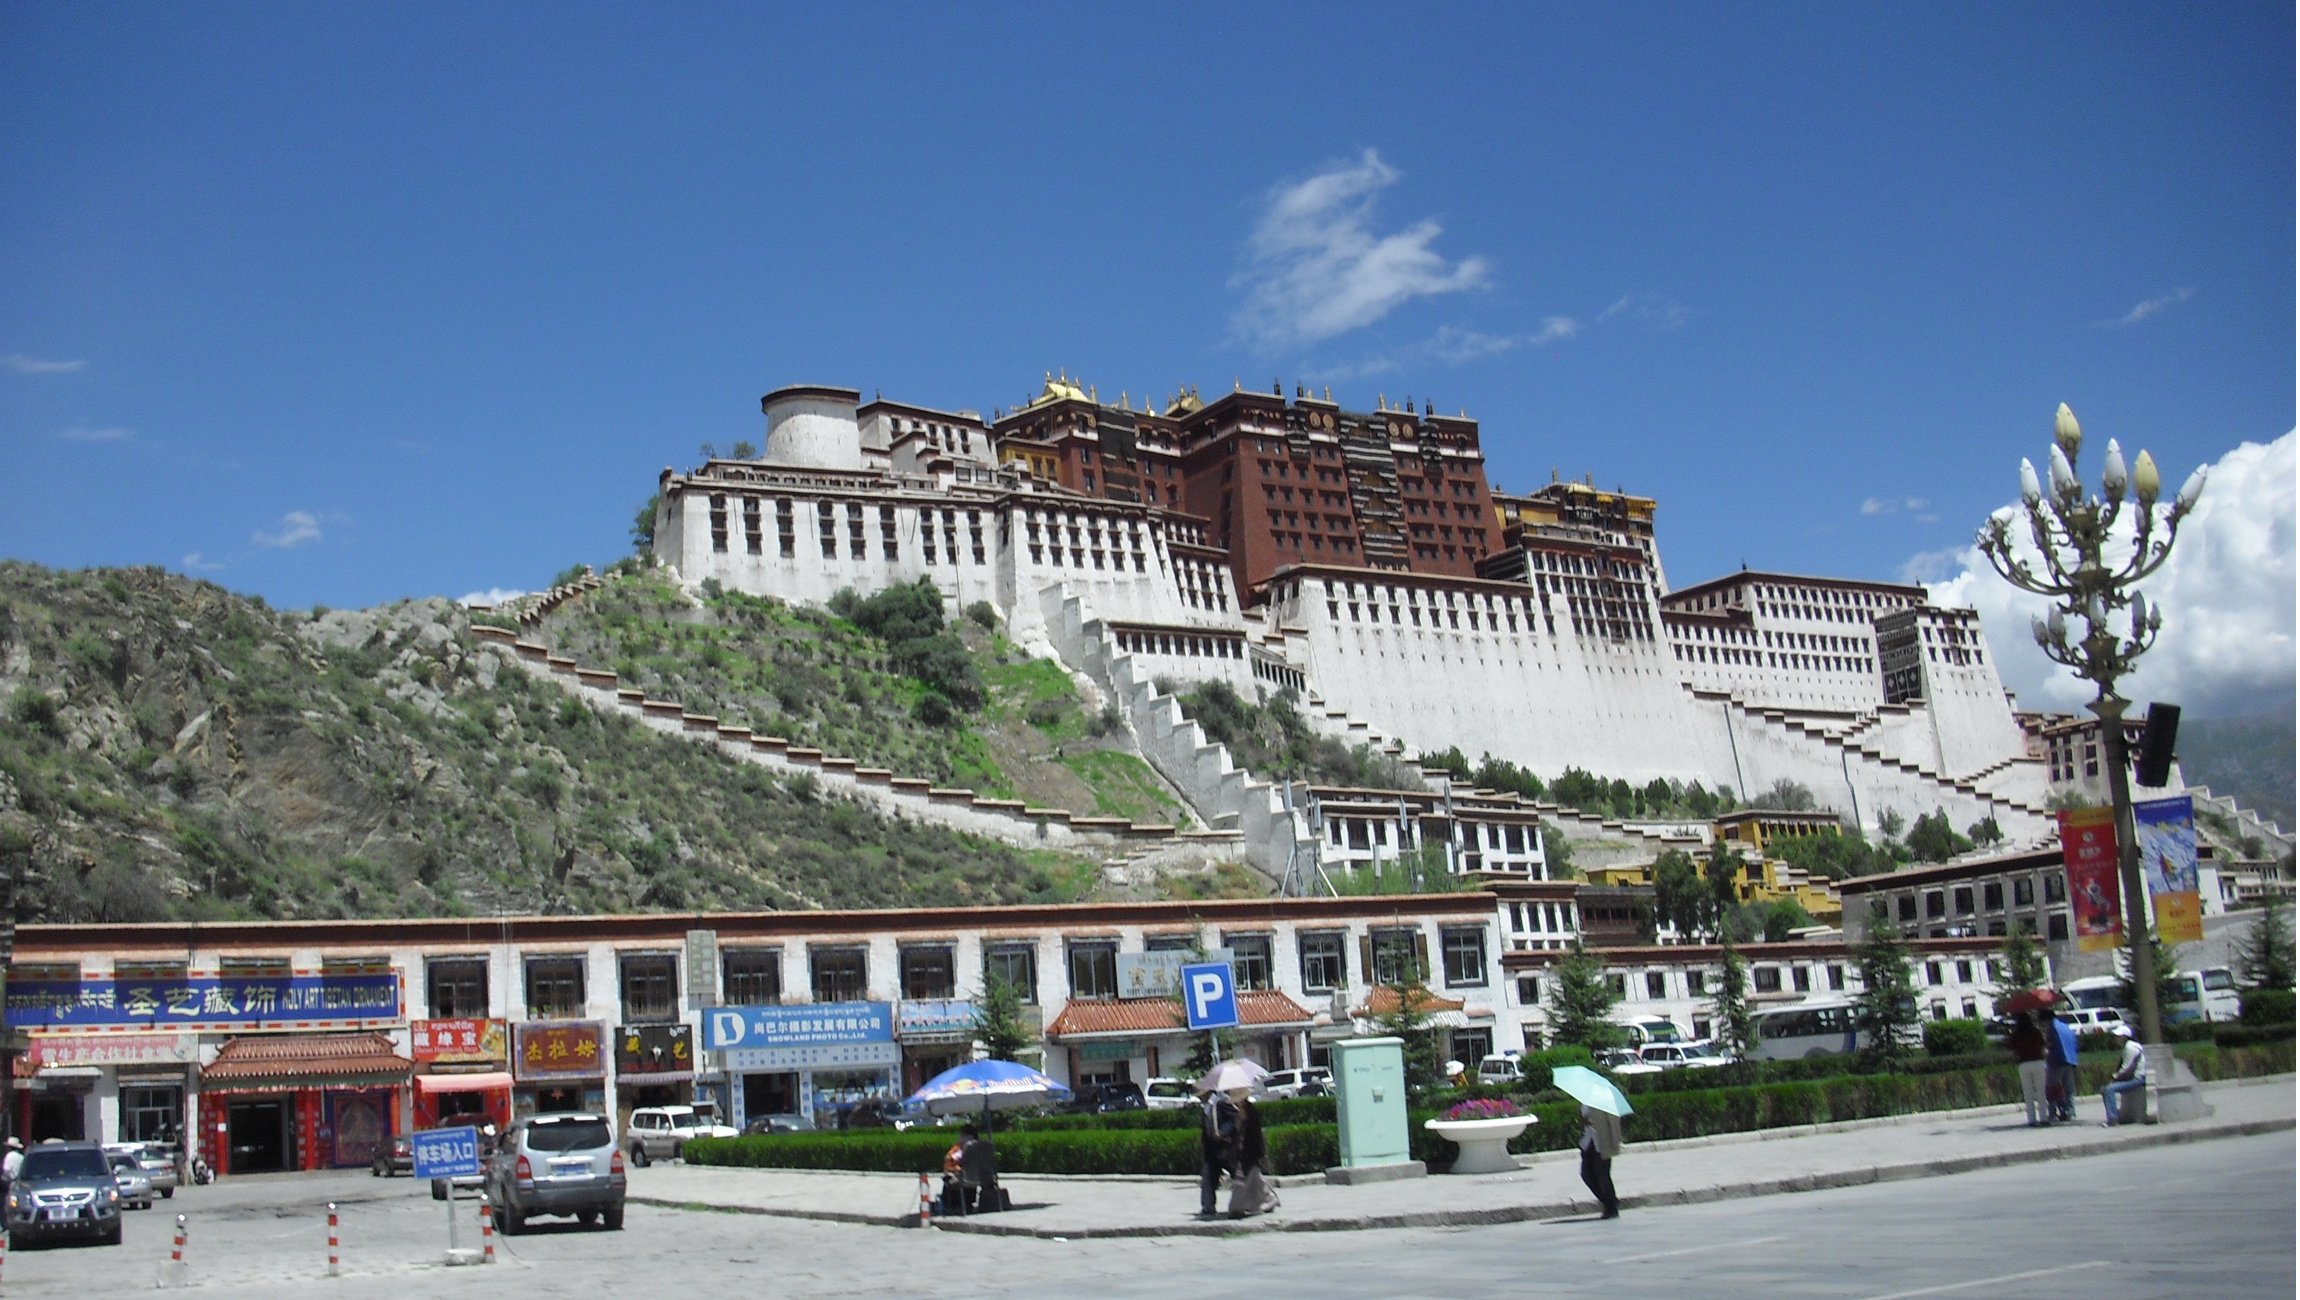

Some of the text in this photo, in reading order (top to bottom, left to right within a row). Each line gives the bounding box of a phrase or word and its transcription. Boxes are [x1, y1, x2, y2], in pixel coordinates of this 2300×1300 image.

[282, 985, 395, 1011] HOLY ART TIBETAN ORNAMENT
[1192, 972, 1225, 1019] P
[768, 1033, 810, 1043] SNOWLAND
[811, 1032, 837, 1041] PHOTO
